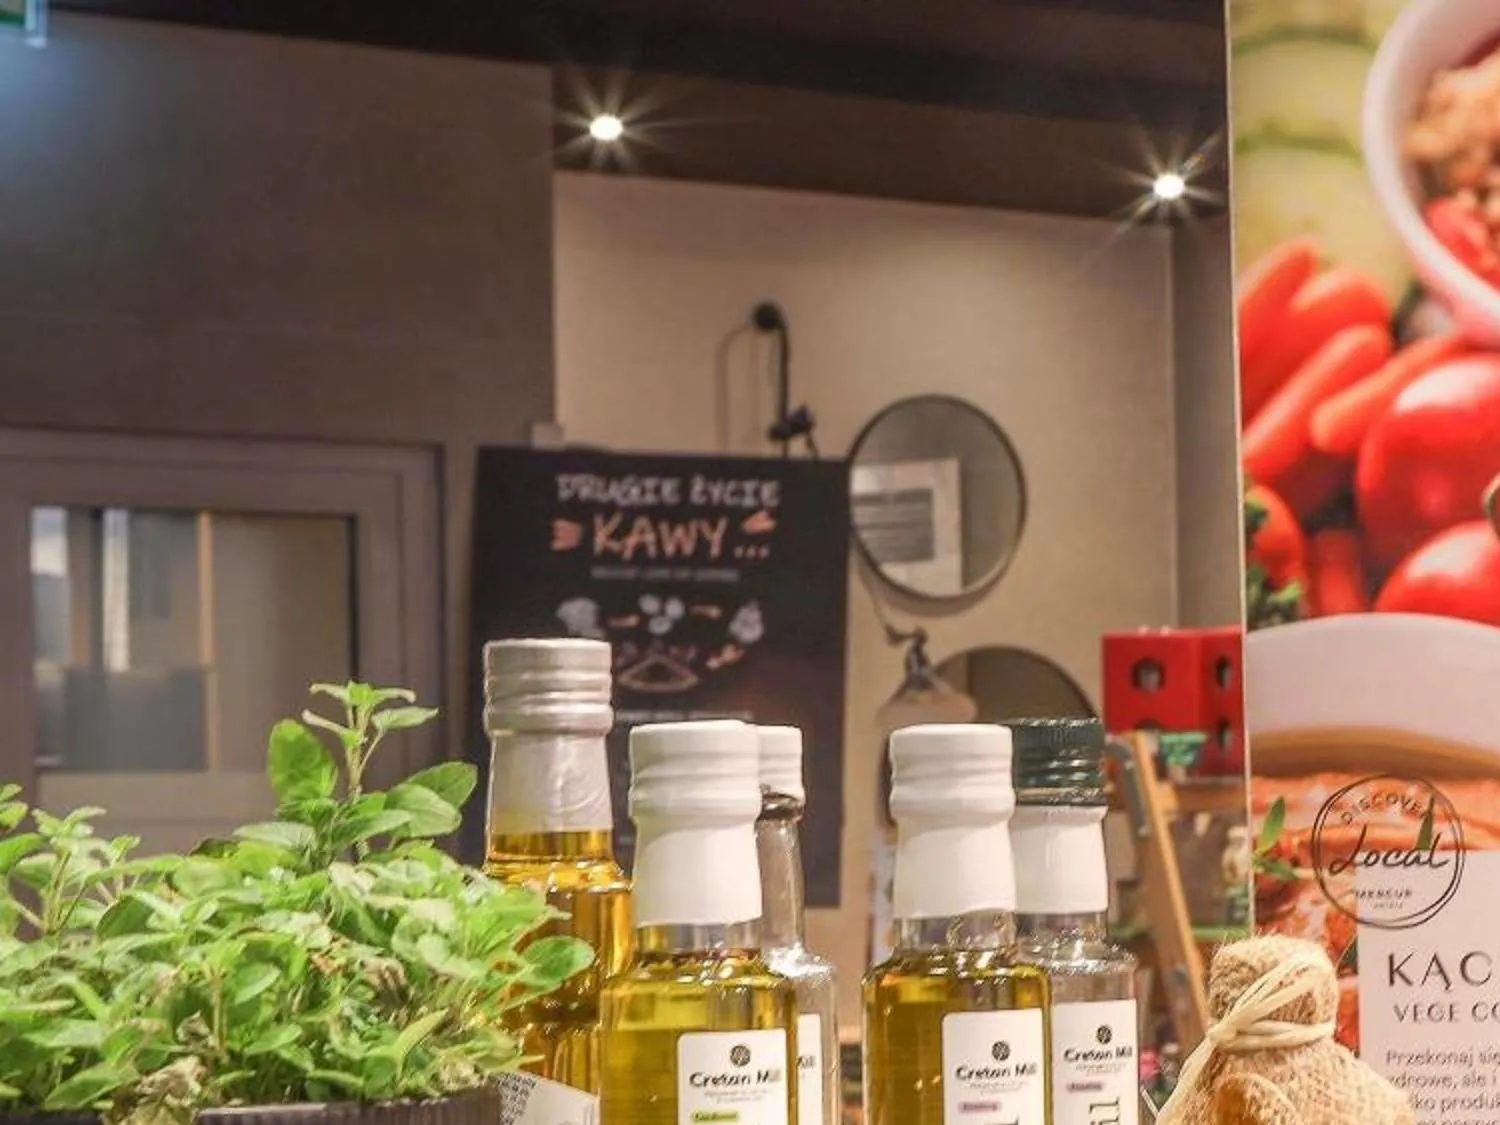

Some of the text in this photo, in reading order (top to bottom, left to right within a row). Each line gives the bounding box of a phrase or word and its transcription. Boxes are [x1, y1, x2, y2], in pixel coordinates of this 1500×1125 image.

[1328, 823, 1449, 877] Local
[1393, 1001, 1461, 1023] VEGE
[1386, 1048, 1474, 1067] Przekonaj
[1462, 1070, 1487, 1087] ale
